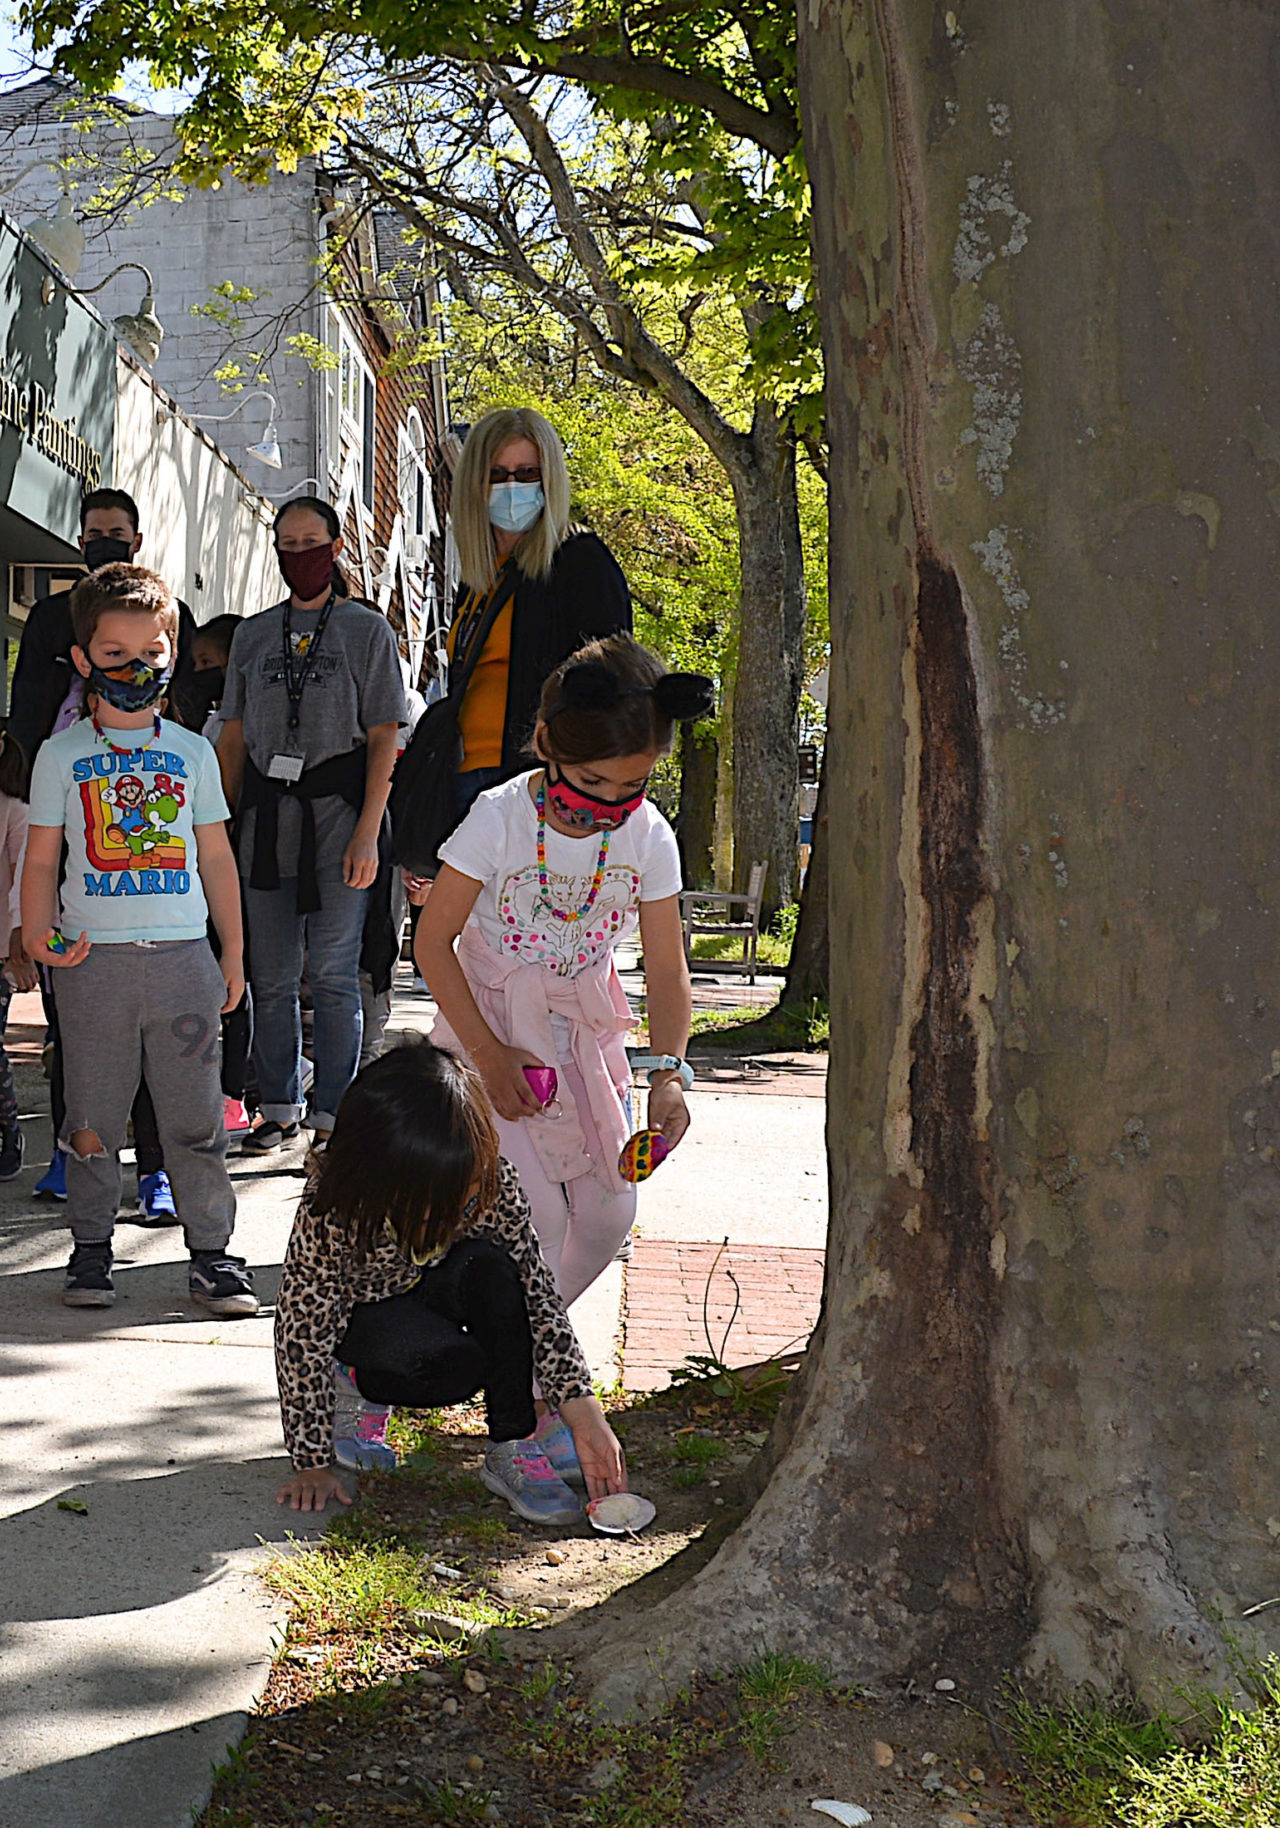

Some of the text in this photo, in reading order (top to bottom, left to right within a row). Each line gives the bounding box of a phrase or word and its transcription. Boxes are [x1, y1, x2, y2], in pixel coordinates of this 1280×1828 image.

[32, 381, 102, 495] Paintings
[73, 750, 189, 782] SUPER
[153, 773, 186, 808] 85
[83, 870, 191, 897] MARIO
